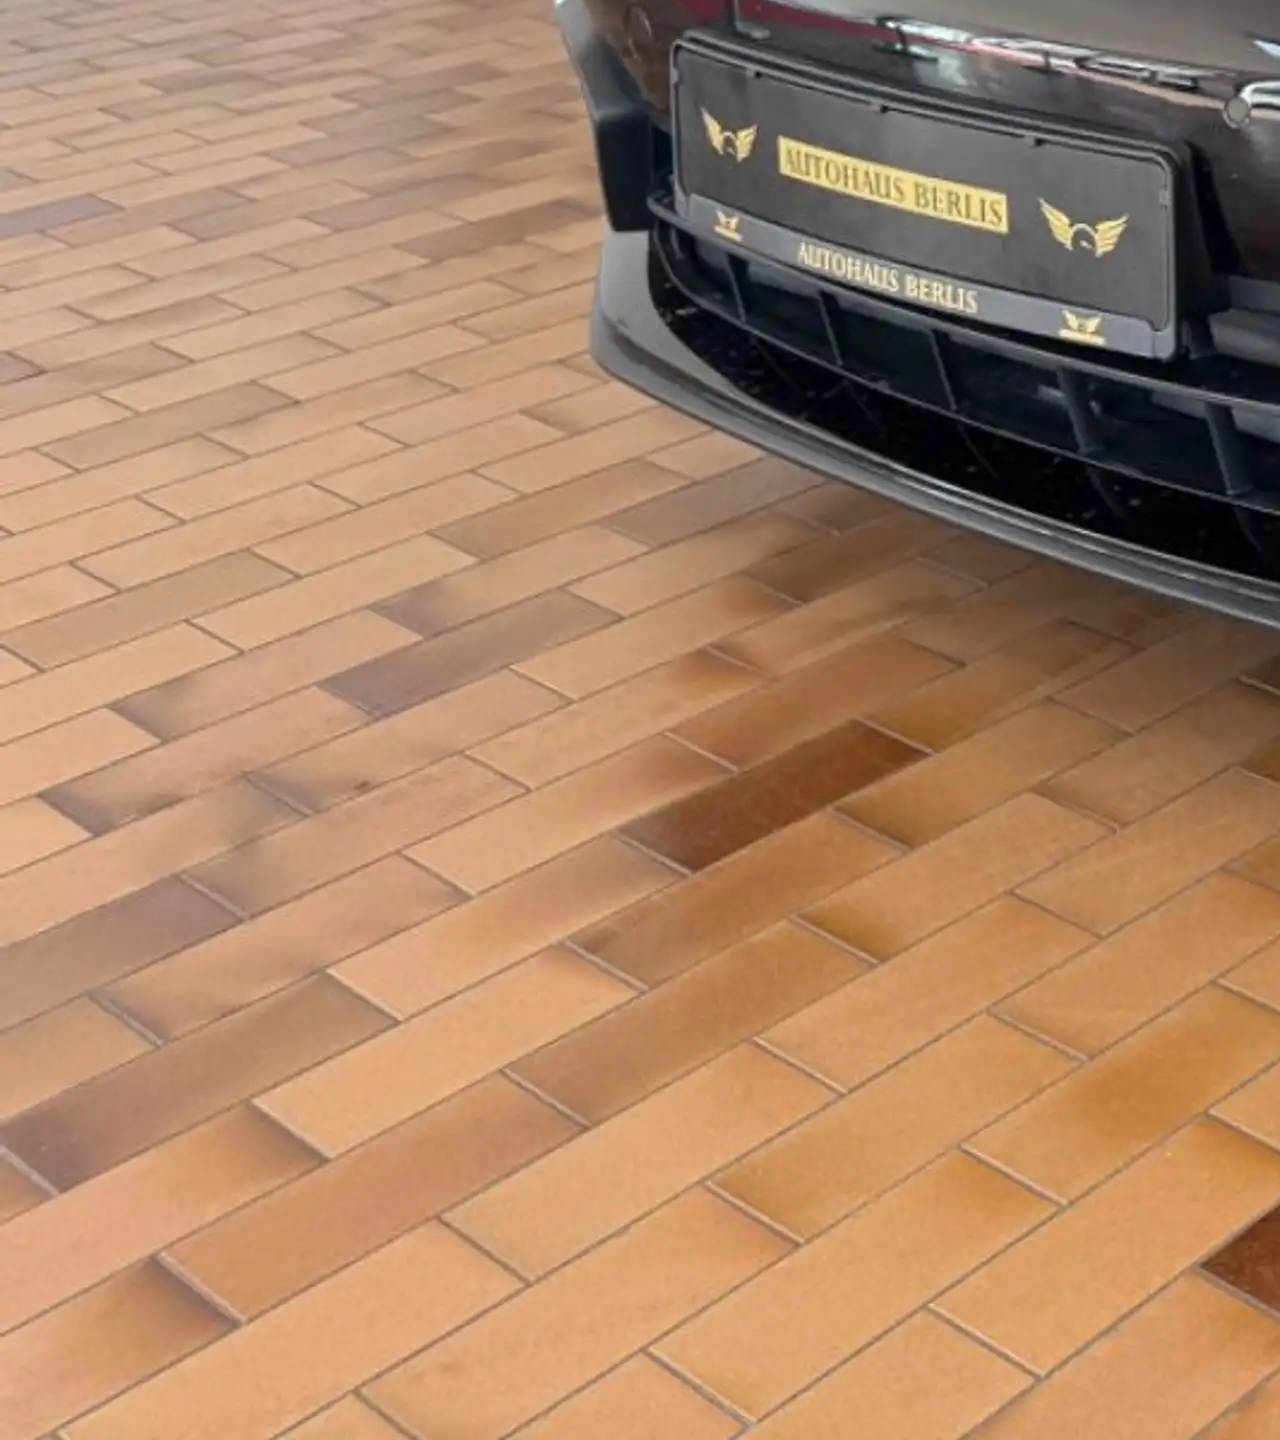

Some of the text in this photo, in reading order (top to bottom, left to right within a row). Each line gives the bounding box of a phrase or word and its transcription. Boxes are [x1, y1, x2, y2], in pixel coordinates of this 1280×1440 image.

[783, 145, 1004, 227] AUTOHAUS BERLIS
[797, 241, 978, 314] AUTOHAUS BERLIS
